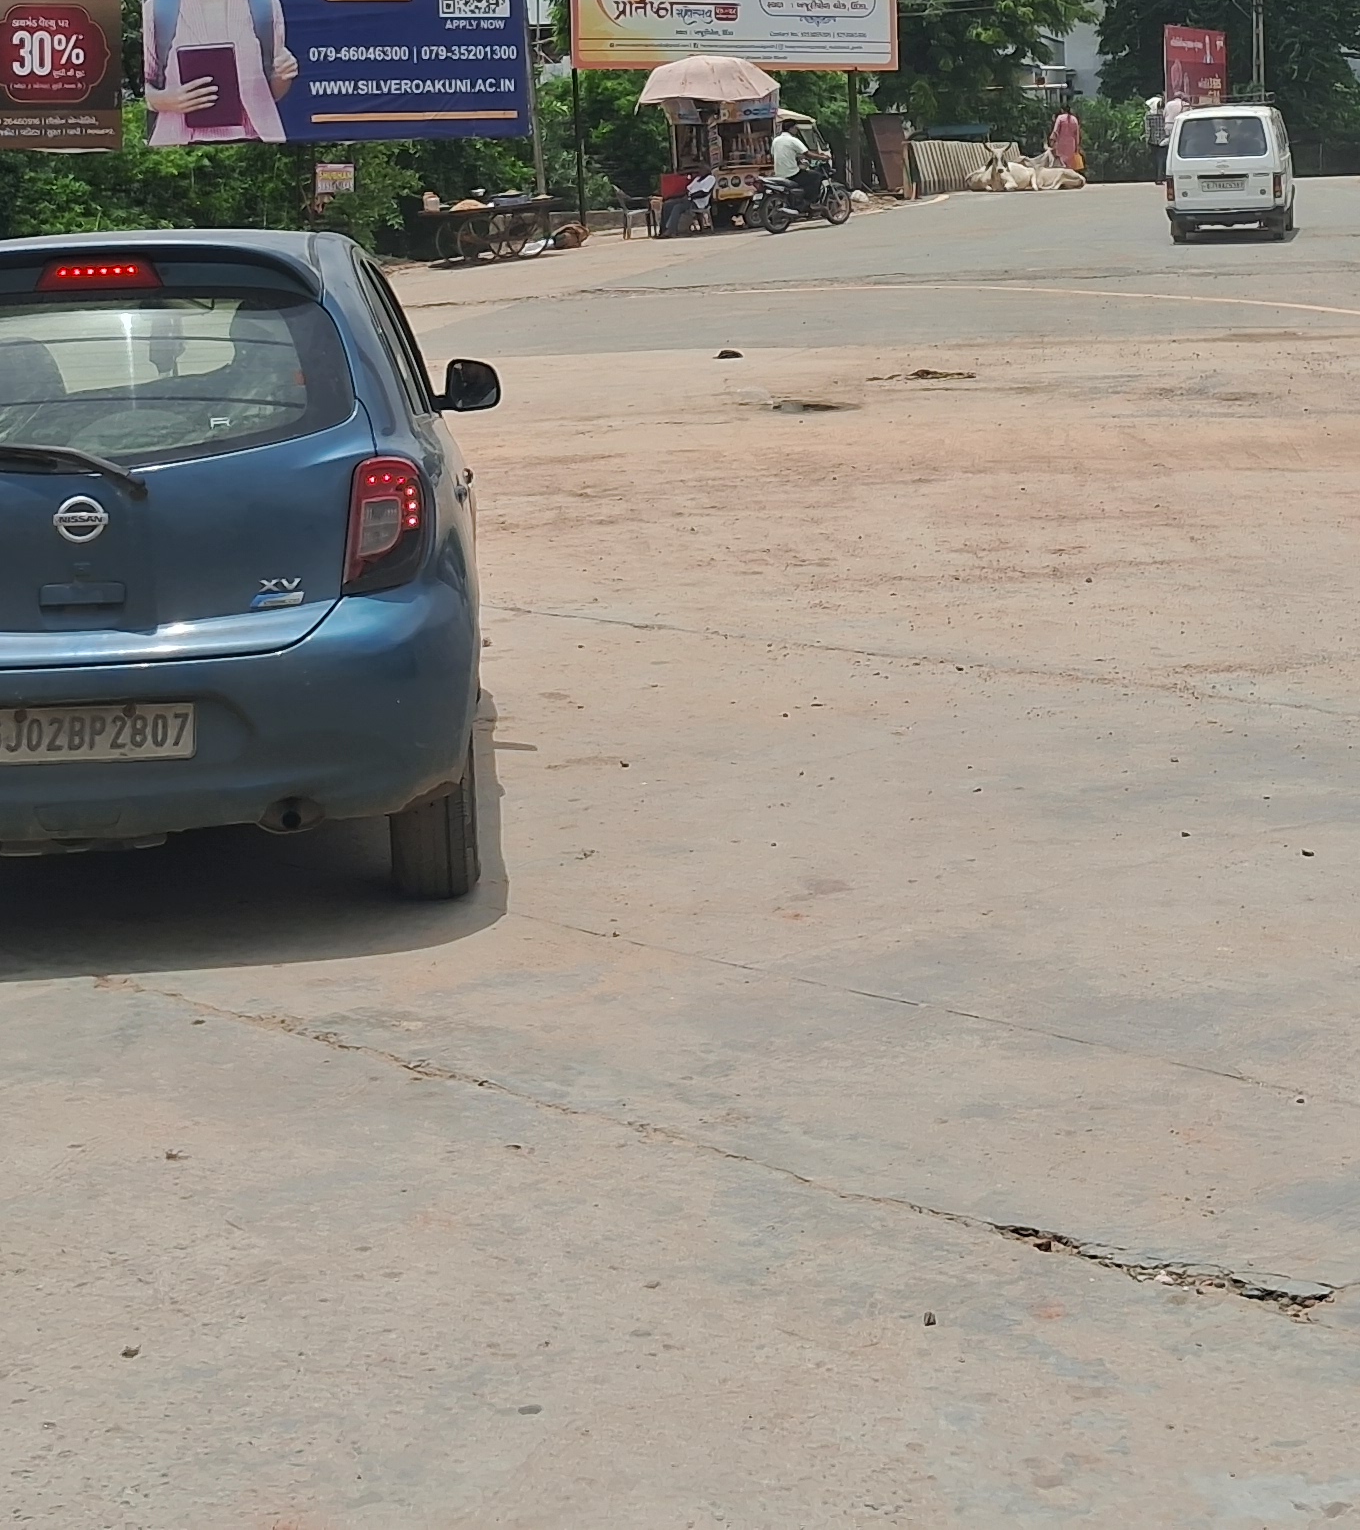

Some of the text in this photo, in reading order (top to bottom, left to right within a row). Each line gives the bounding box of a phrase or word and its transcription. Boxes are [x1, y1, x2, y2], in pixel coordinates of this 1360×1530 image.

[445, 19, 505, 30] APPLY NOW
[309, 45, 517, 62] 079-66046300 079-35201300
[309, 78, 515, 95] WWW.SILVEROAKUNI.AC.IN
[59, 515, 103, 524] NISSAN
[259, 577, 301, 592] XV
